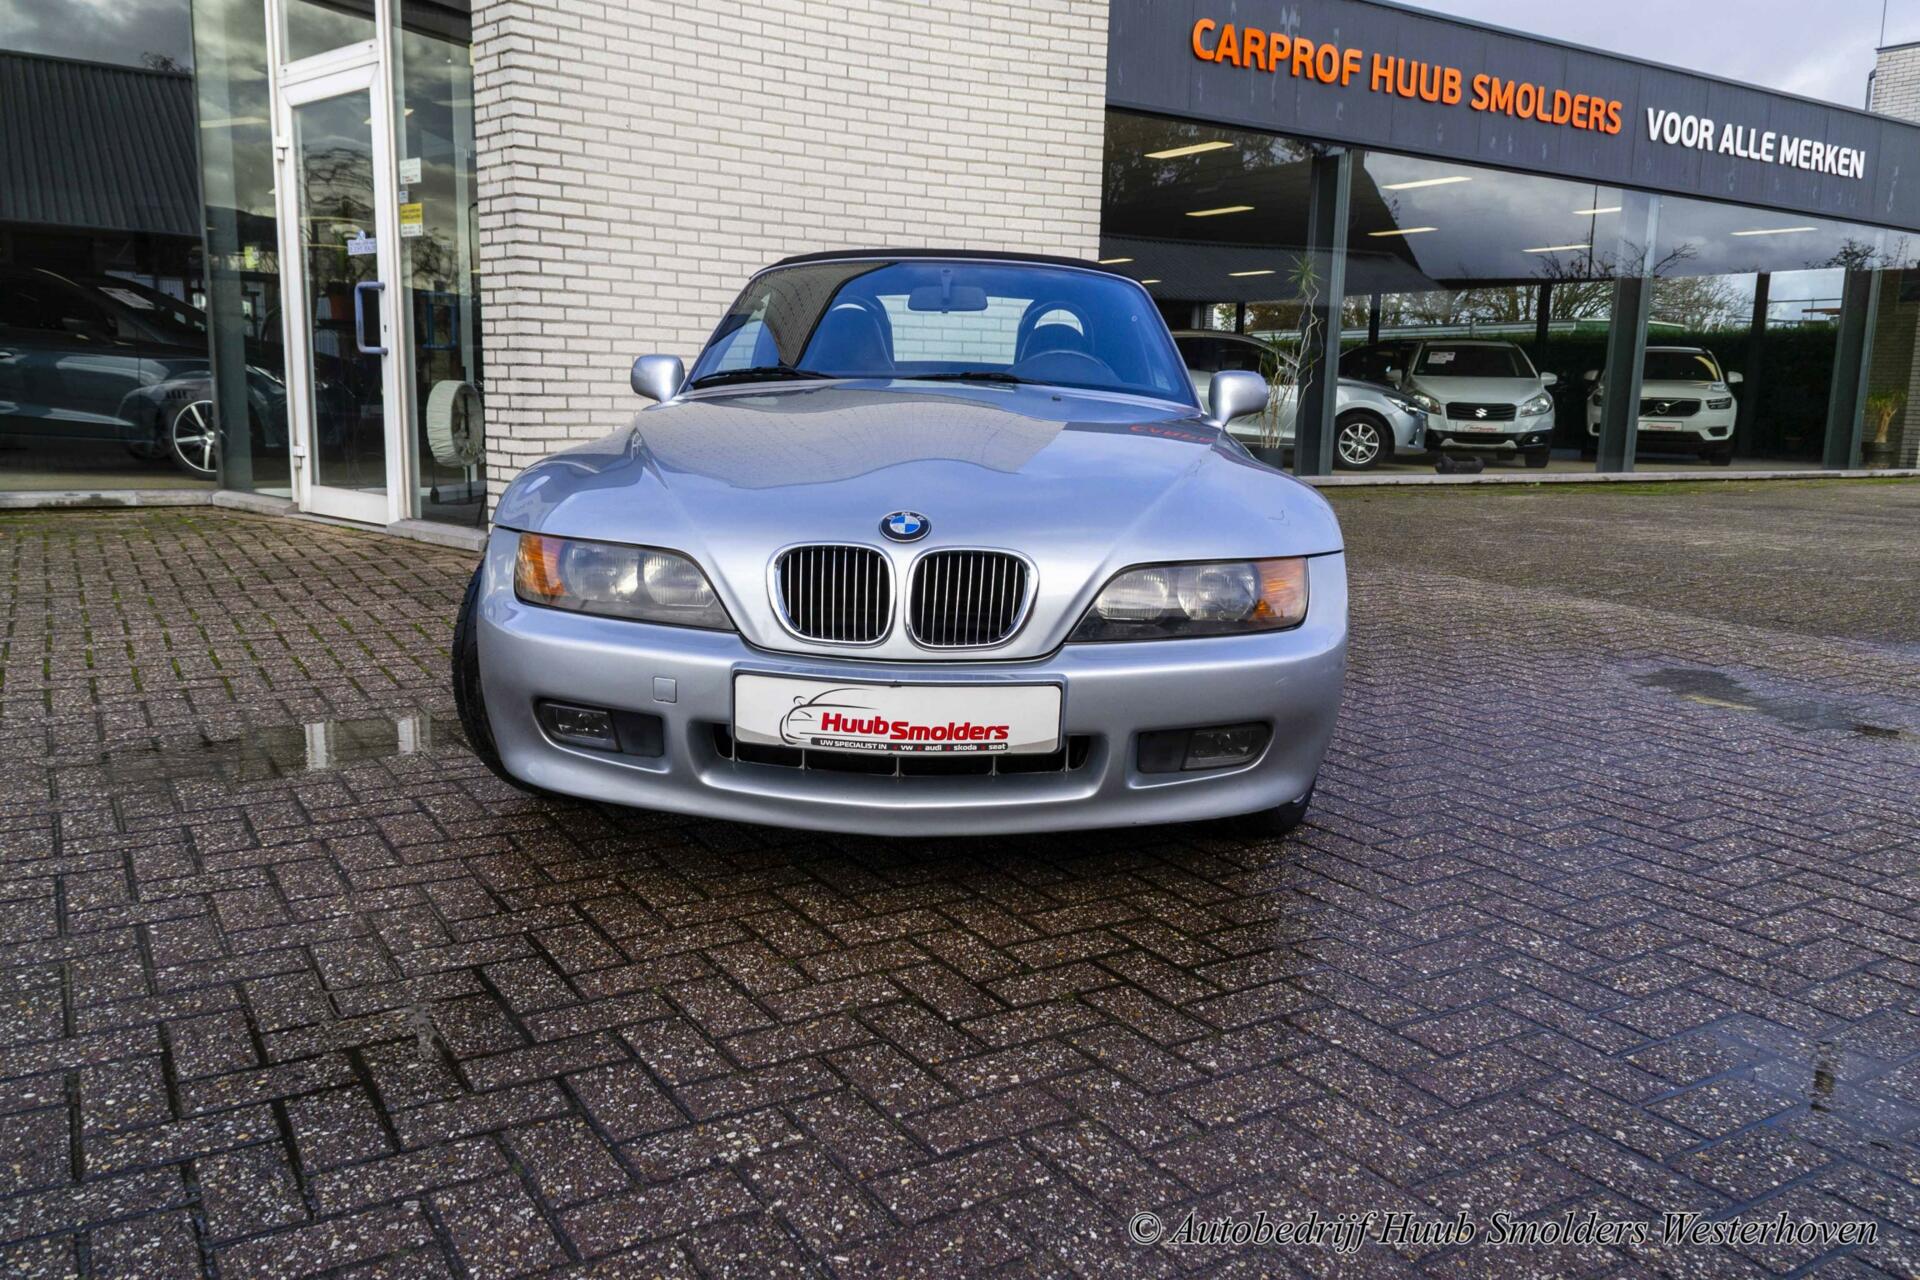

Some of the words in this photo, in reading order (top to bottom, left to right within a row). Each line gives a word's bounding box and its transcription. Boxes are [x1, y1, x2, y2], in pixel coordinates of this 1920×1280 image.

[1192, 18, 1362, 87] CARPROF
[1371, 53, 1462, 107] HUUB
[1470, 73, 1623, 135] SMOLDERS
[1646, 107, 1714, 150] VOOR
[1719, 123, 1776, 163] ALLE
[1778, 134, 1866, 180] MERKEN
[834, 741, 877, 749] SPECIALIST
[988, 743, 1006, 751] seat
